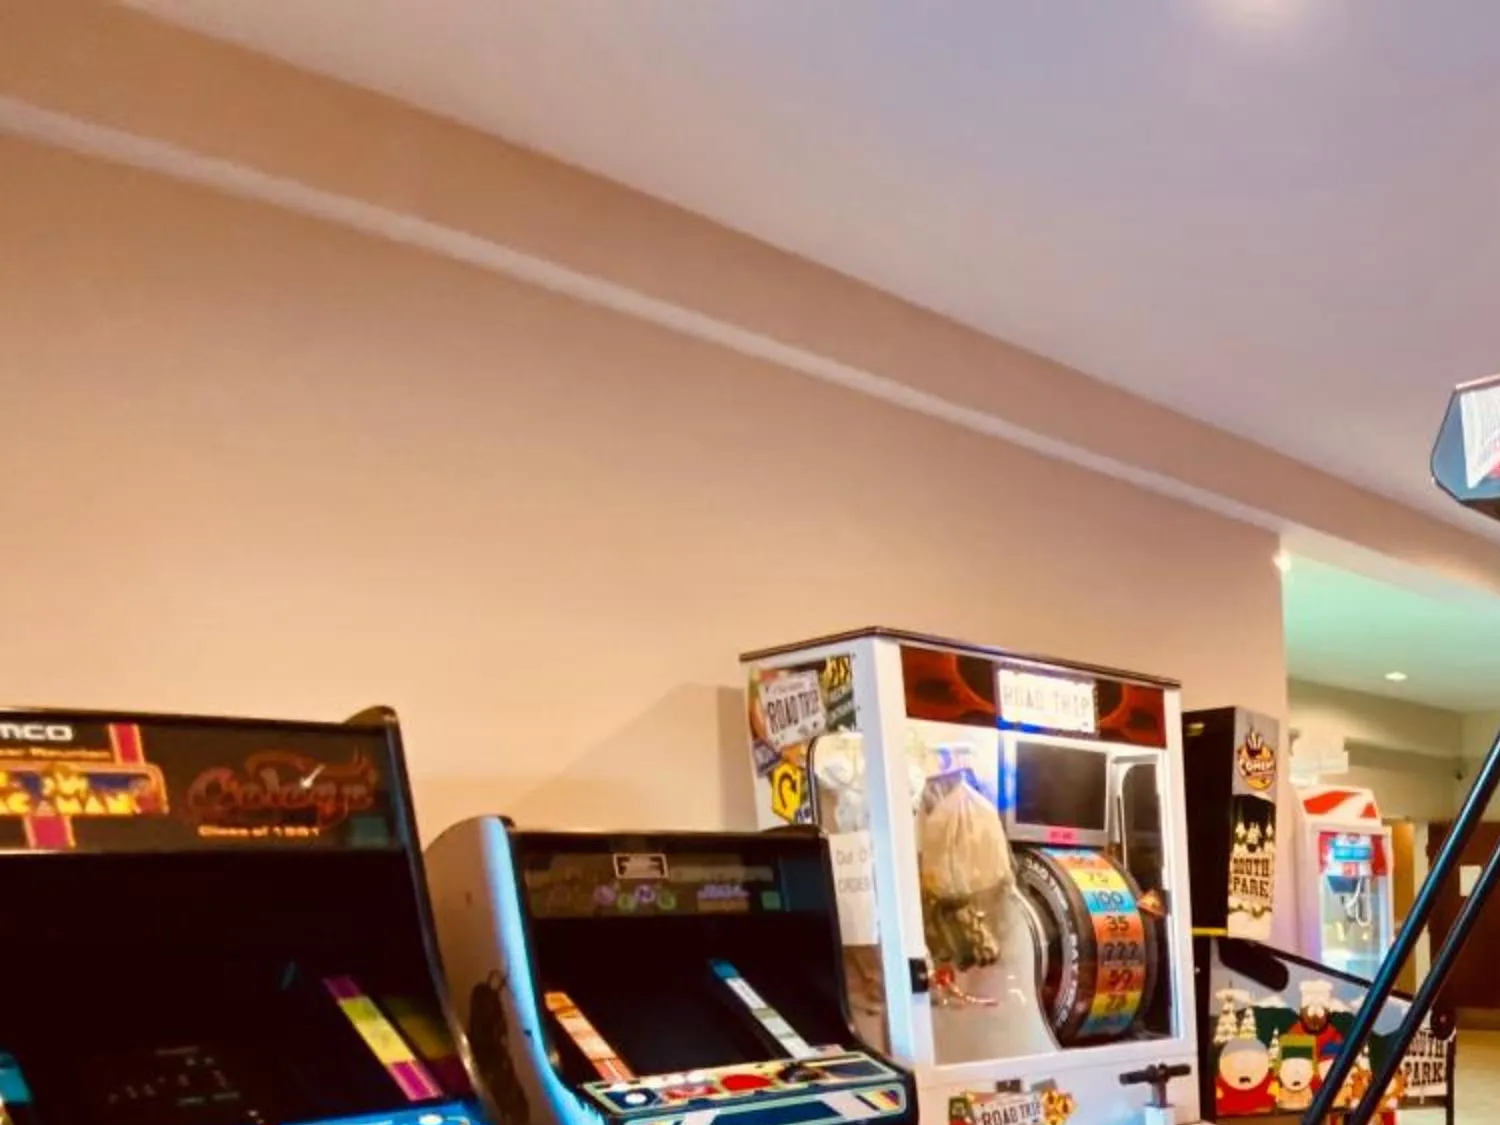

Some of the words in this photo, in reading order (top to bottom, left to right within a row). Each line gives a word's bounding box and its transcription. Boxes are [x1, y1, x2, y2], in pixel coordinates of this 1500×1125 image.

[1232, 857, 1271, 878] SOUTH
[1231, 875, 1270, 899] PARK
[1105, 916, 1129, 931] 35
[1403, 1060, 1444, 1087] PARK
